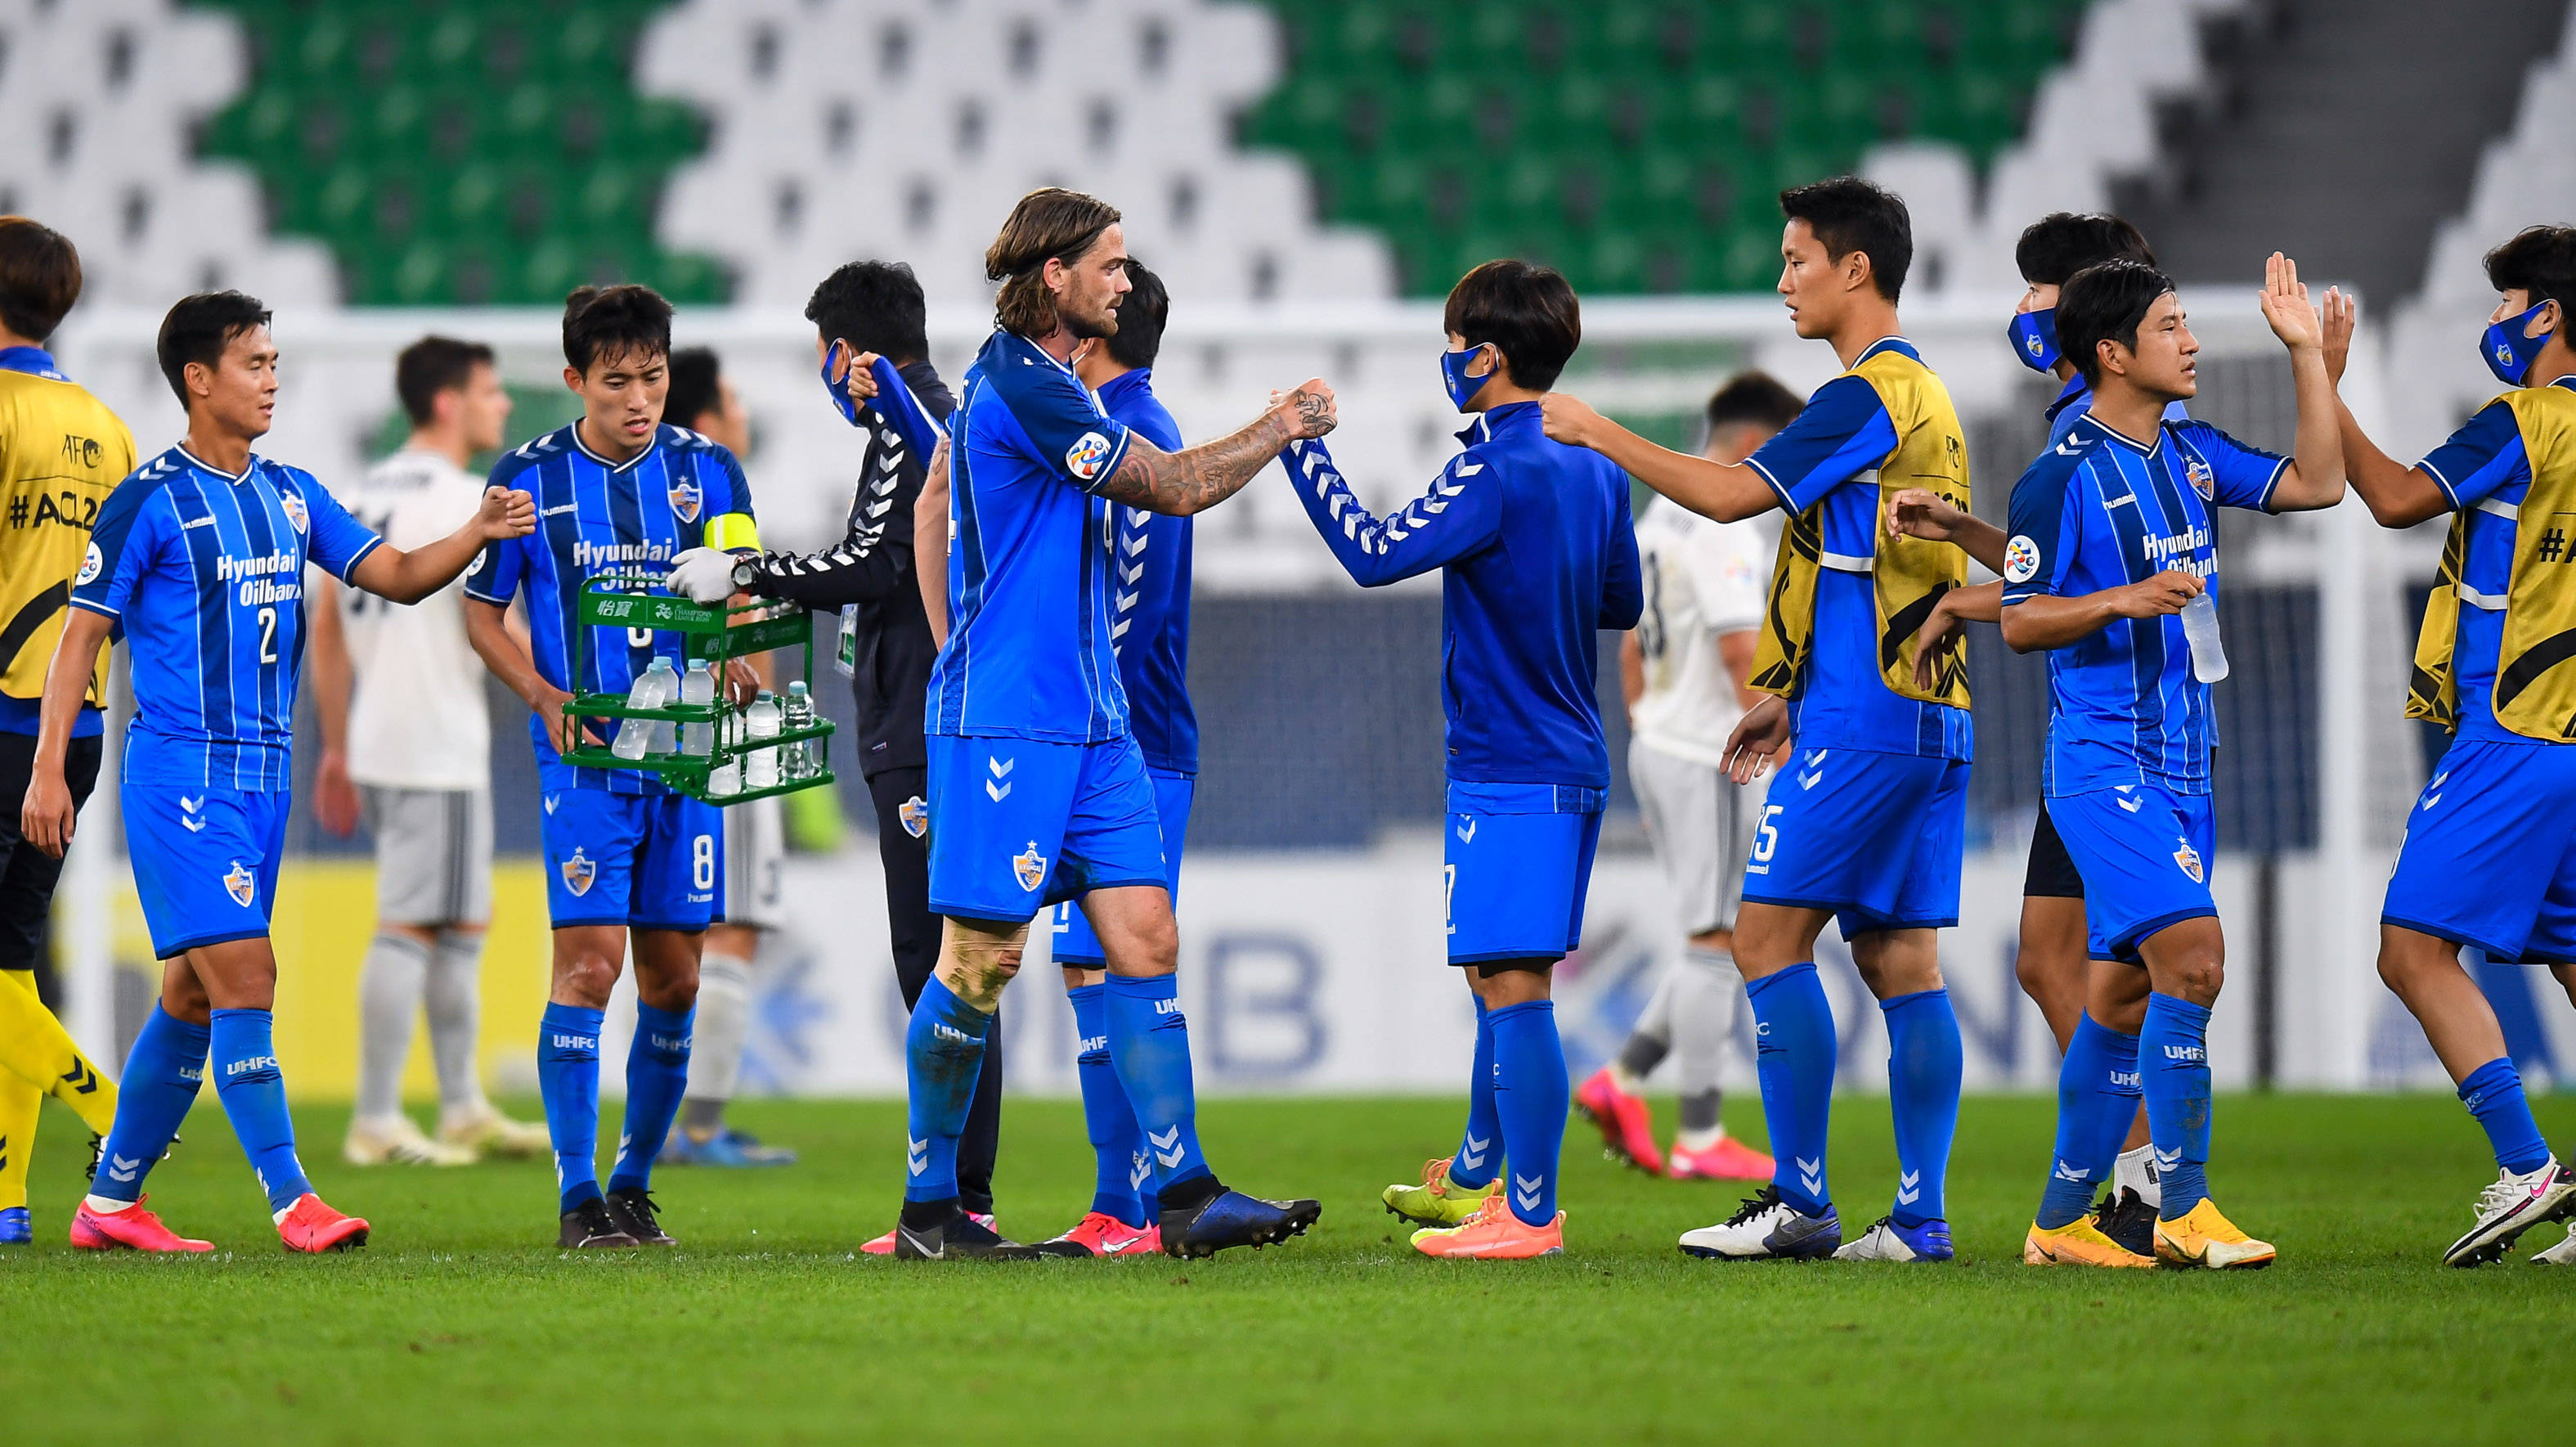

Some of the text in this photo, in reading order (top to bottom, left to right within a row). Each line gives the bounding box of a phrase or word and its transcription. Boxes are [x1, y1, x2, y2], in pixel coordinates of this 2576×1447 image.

[10, 491, 106, 532] #ACL2
[539, 501, 579, 518] hummel
[2102, 491, 2137, 511] hummel
[573, 537, 672, 568] Hyundai
[2143, 520, 2208, 562] Hyundai
[217, 548, 296, 583] Hyundai
[258, 608, 278, 664] 2
[693, 834, 714, 890] 8
[553, 1034, 595, 1049] UHFC
[227, 1056, 279, 1076] UHFC
